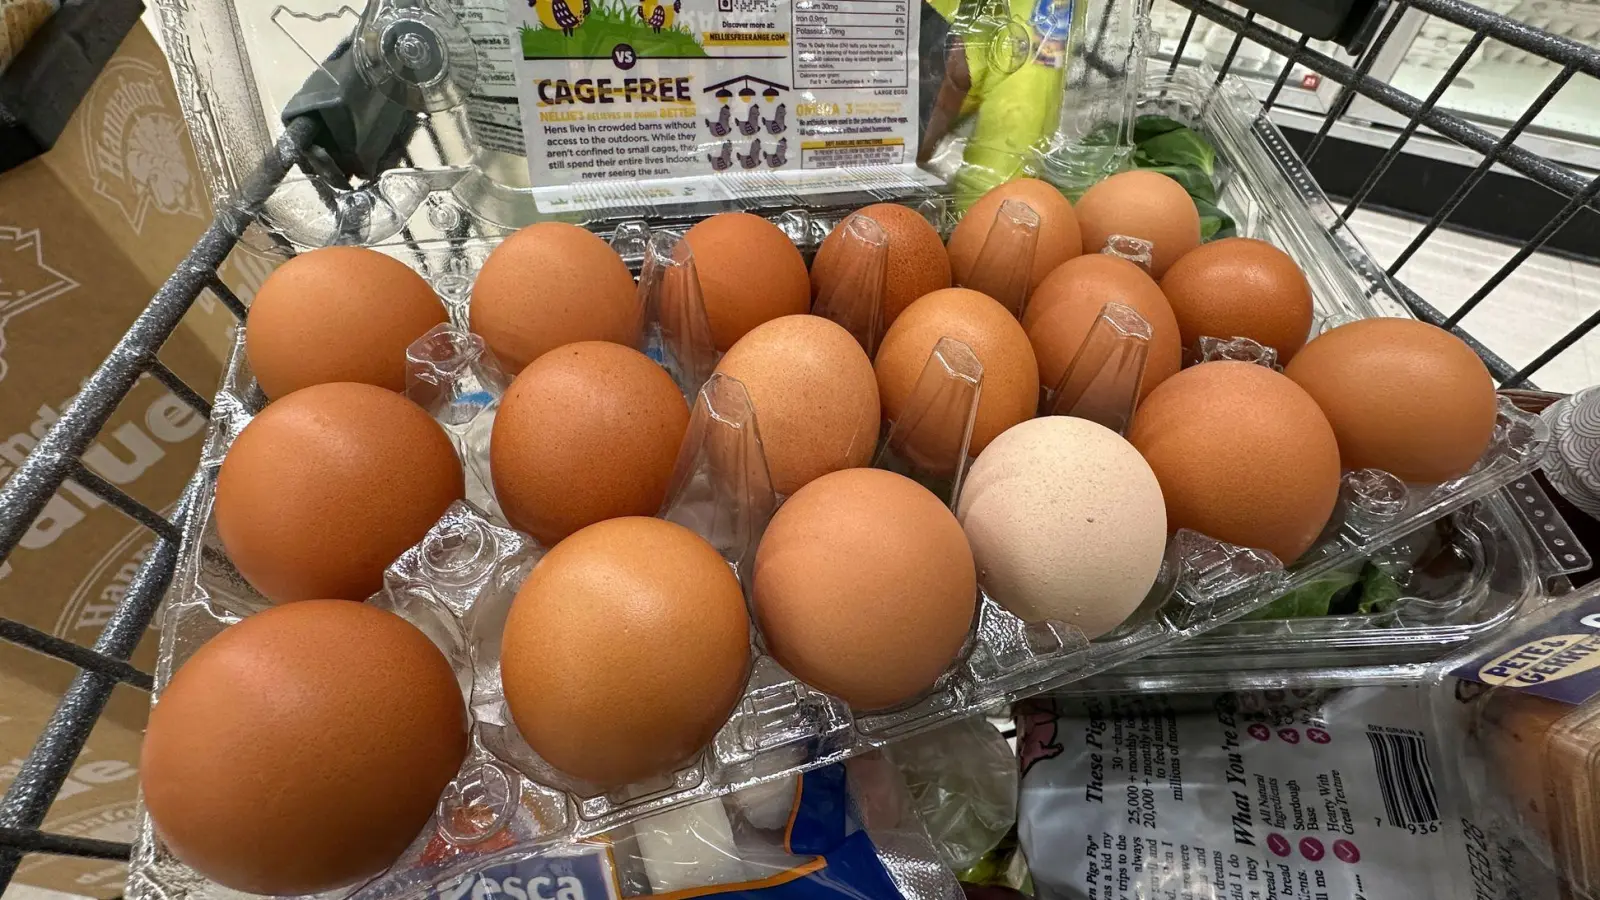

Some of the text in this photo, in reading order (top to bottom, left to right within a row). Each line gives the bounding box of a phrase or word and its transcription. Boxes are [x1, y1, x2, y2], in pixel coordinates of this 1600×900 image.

[710, 32, 786, 42] NELLIESFREERANGE.COM
[722, 21, 747, 29] Discover
[829, 28, 845, 36] 70mg
[615, 50, 633, 64] VS
[538, 77, 692, 105] CAGE-FREE
[540, 112, 584, 122] NELLIE'S
[660, 108, 696, 118] BETTER
[544, 121, 696, 134] Hens live in crowded barns without
[546, 148, 574, 158] aren't
[576, 146, 614, 157] confined
[616, 146, 626, 154] to
[628, 144, 650, 154] small
[652, 146, 678, 154] cages,
[547, 132, 696, 146] access to the outdoors. While they
[548, 154, 700, 170] still spend their entire lives indoors,
[582, 167, 671, 179] never seeing the sun.
[1482, 646, 1554, 678] PETE
[1086, 712, 1107, 750] Pig
[1368, 724, 1416, 736] SIX GRAIN
[1112, 756, 1124, 770] 30
[1125, 732, 1138, 773] monthly
[1152, 744, 1166, 779] to feed
[1222, 730, 1247, 787] You're
[1086, 753, 1104, 804] These
[1140, 732, 1158, 830] 20,000 + monthly
[1166, 742, 1183, 802] millions of
[1127, 786, 1142, 825] 25,000
[1253, 773, 1272, 827] All Natural
[1269, 777, 1286, 830] Ingredients
[1286, 780, 1305, 830] Sourdough
[1316, 774, 1340, 832] Hearty With
[1332, 770, 1354, 836] Great Texture
[1232, 790, 1256, 847] What
[1306, 807, 1320, 830] Base
[1407, 820, 1443, 835] 936
[1102, 832, 1114, 850] my
[1132, 836, 1144, 872] always
[1146, 838, 1158, 859] and
[1086, 834, 1100, 885] Pigs Fly"
[1101, 854, 1112, 870] kid
[1116, 834, 1130, 892] trips to the
[1193, 847, 1206, 868] and
[1212, 850, 1226, 890] dreams
[1228, 854, 1240, 868] do
[1246, 856, 1259, 880] they
[1277, 864, 1293, 896] bread
[1316, 869, 1327, 888] me
